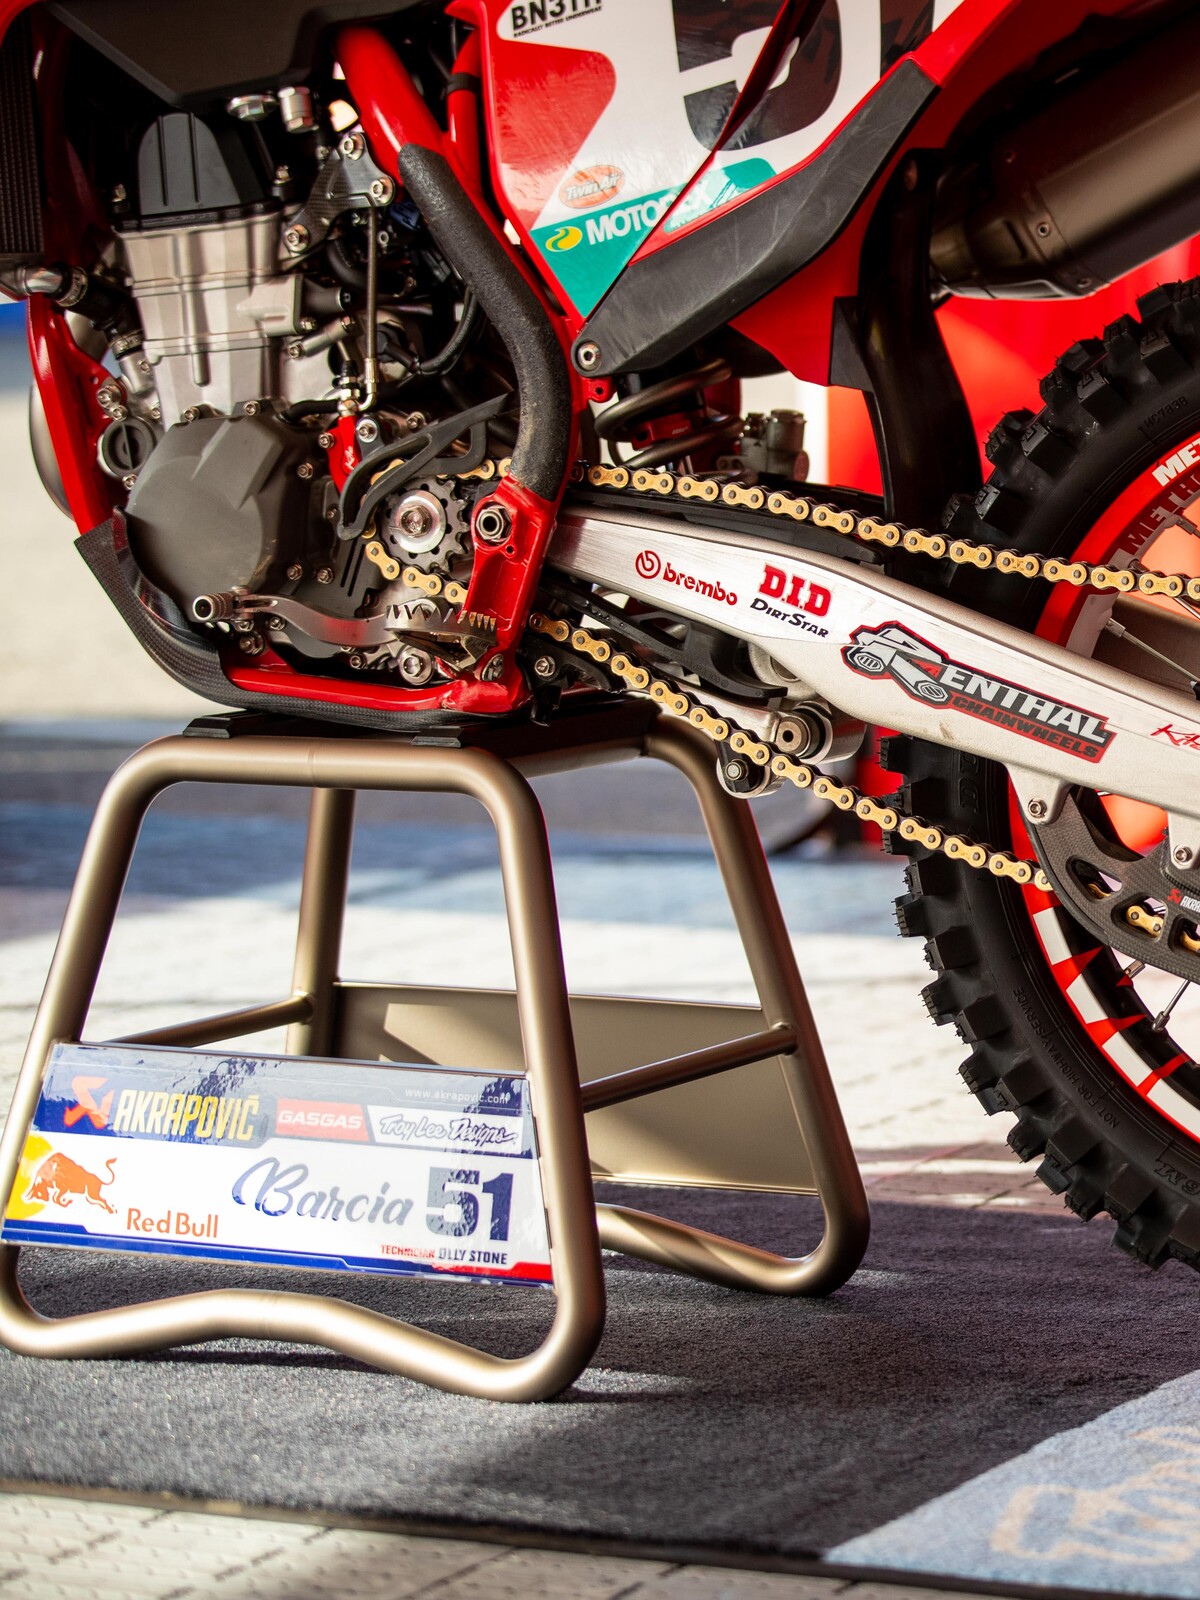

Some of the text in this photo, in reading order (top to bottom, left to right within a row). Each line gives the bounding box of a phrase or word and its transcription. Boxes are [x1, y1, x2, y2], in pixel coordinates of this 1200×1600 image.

[565, 171, 621, 200] Twin Air
[663, 562, 738, 606] brembo
[951, 697, 1099, 759] CHAINWHEELS
[1043, 1038, 1080, 1084] HIGHWAY
[405, 1087, 509, 1105] www.akrapovic.com
[1075, 1083, 1102, 1109] FOR
[278, 1109, 363, 1130] GASGAS
[380, 1114, 416, 1141] Troy
[414, 1116, 447, 1139] Lee
[448, 1118, 519, 1147] Designs
[1098, 1108, 1120, 1129] NOT
[231, 1157, 514, 1241] Barcia 51
[126, 1208, 219, 1238] Red Bull
[469, 1250, 508, 1265] STONE
